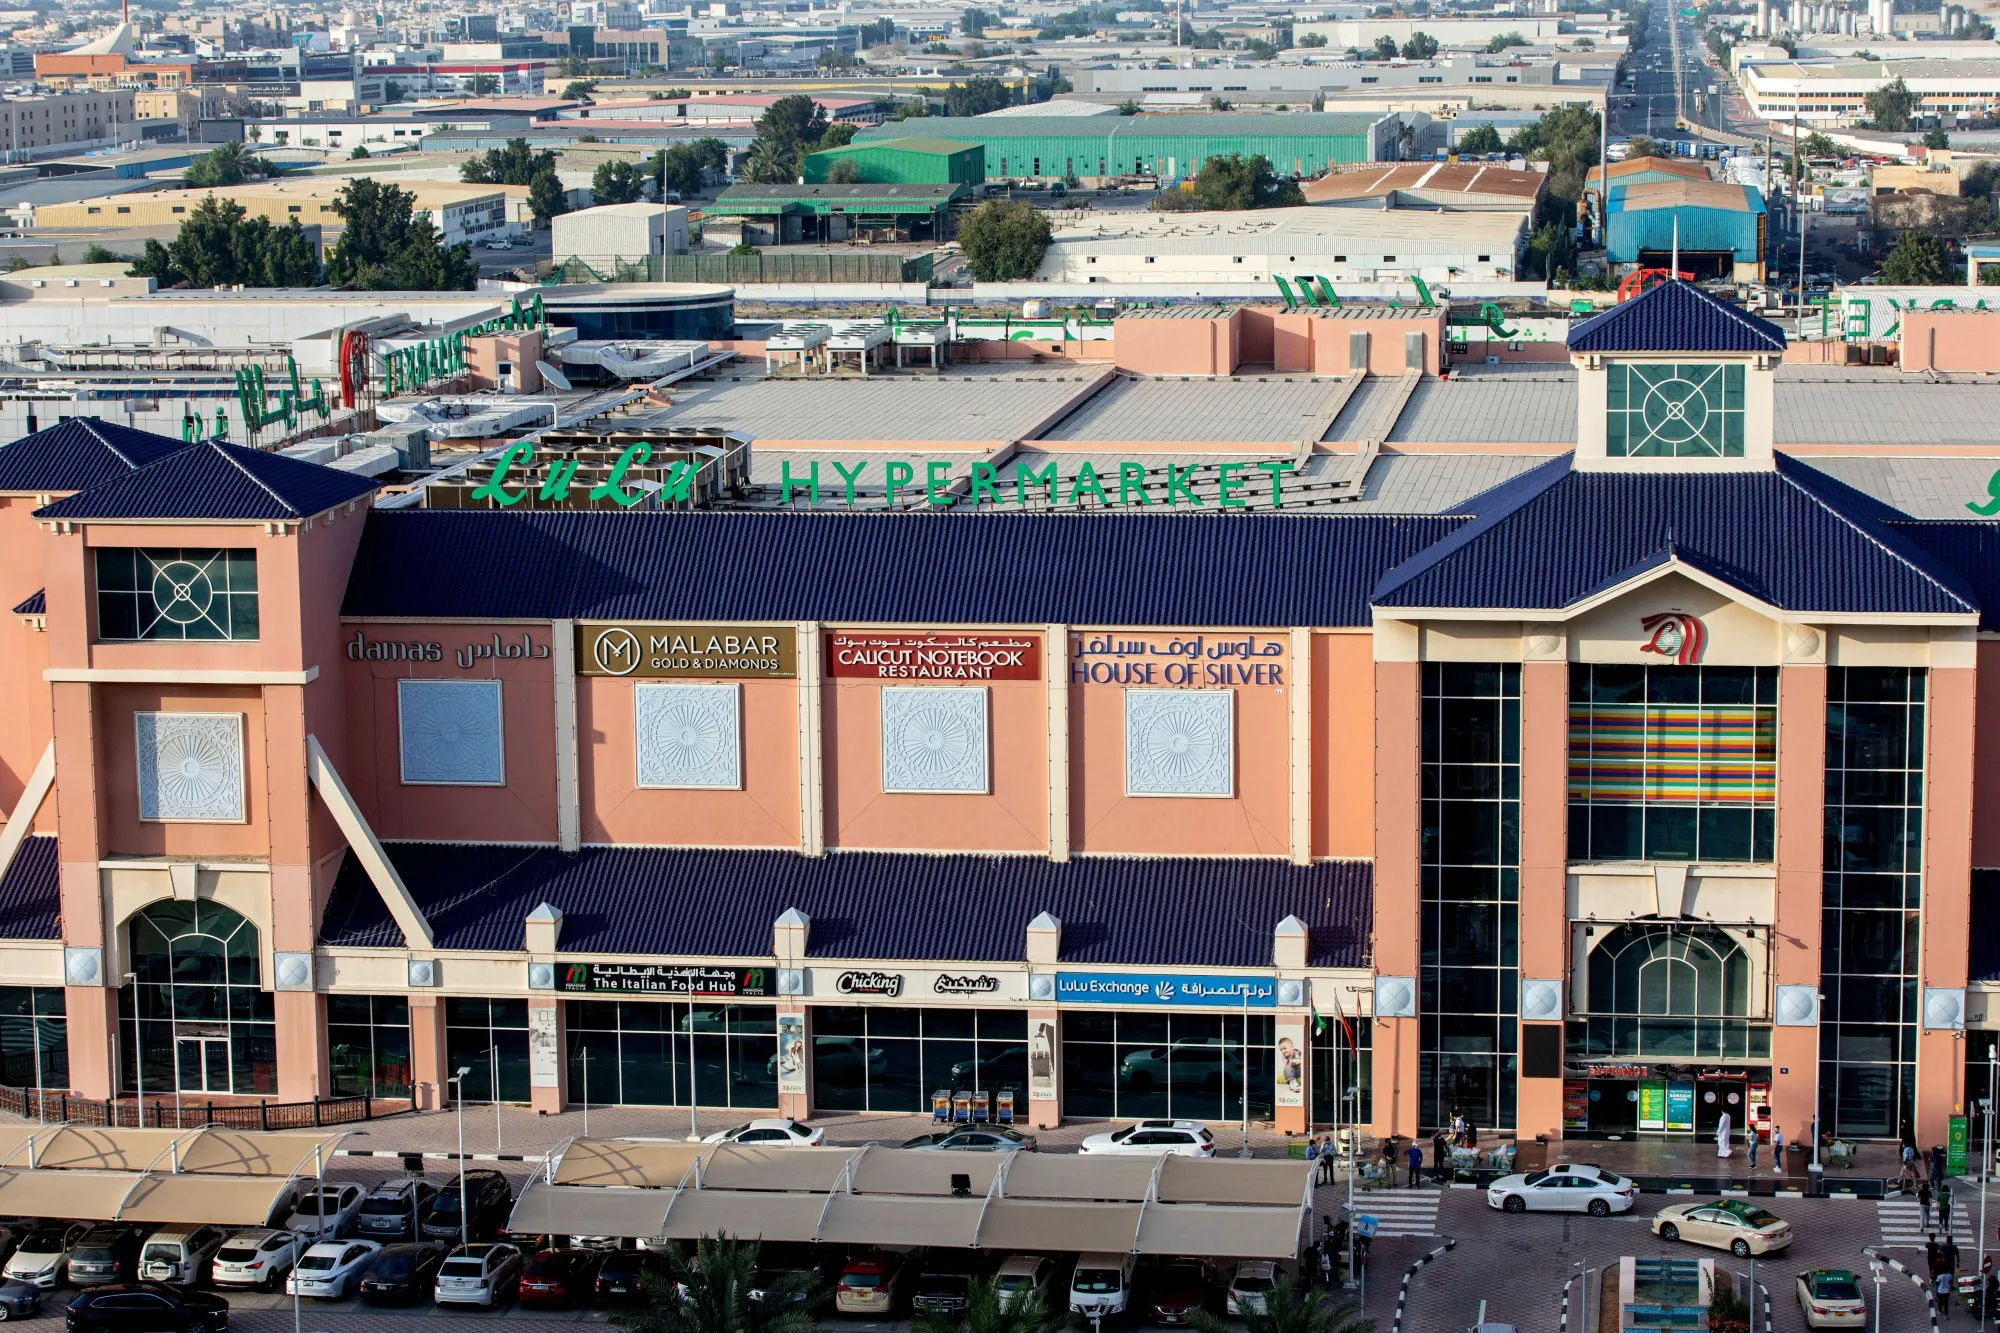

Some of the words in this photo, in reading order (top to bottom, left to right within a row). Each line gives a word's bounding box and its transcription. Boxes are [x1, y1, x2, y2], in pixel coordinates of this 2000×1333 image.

[782, 460, 1295, 507] HYPERMARKET
[347, 632, 443, 661] damas
[650, 635, 779, 655] MALABAR
[834, 637, 867, 648] بوك
[869, 637, 901, 648] نوت
[904, 637, 978, 649] كاليكوت
[977, 638, 1032, 649] مطعم
[1074, 634, 1147, 659] سيلفر
[1207, 635, 1284, 660] هاوس
[455, 632, 550, 669] داماس
[838, 649, 914, 665] CALICUT
[917, 650, 1024, 666] NOTEBOOK
[651, 658, 690, 670] GOLD
[693, 659, 703, 671] &
[705, 659, 779, 671] DIAMONDS
[878, 665, 993, 679] RESTAURANT
[1071, 661, 1158, 685] HOUSE
[1164, 662, 1199, 685] OF
[1206, 662, 1284, 686] SILVER
[699, 967, 736, 980] وجهة
[592, 978, 618, 989] The
[622, 978, 667, 990] Italian
[671, 980, 704, 991] Food
[709, 981, 736, 992] Hub
[837, 972, 900, 997] Chicking
[1059, 979, 1088, 992] LuLu
[1090, 980, 1150, 995] Exchange
[1182, 983, 1241, 997] للصرافة
[1587, 1065, 1648, 1077] ENTRANCE
